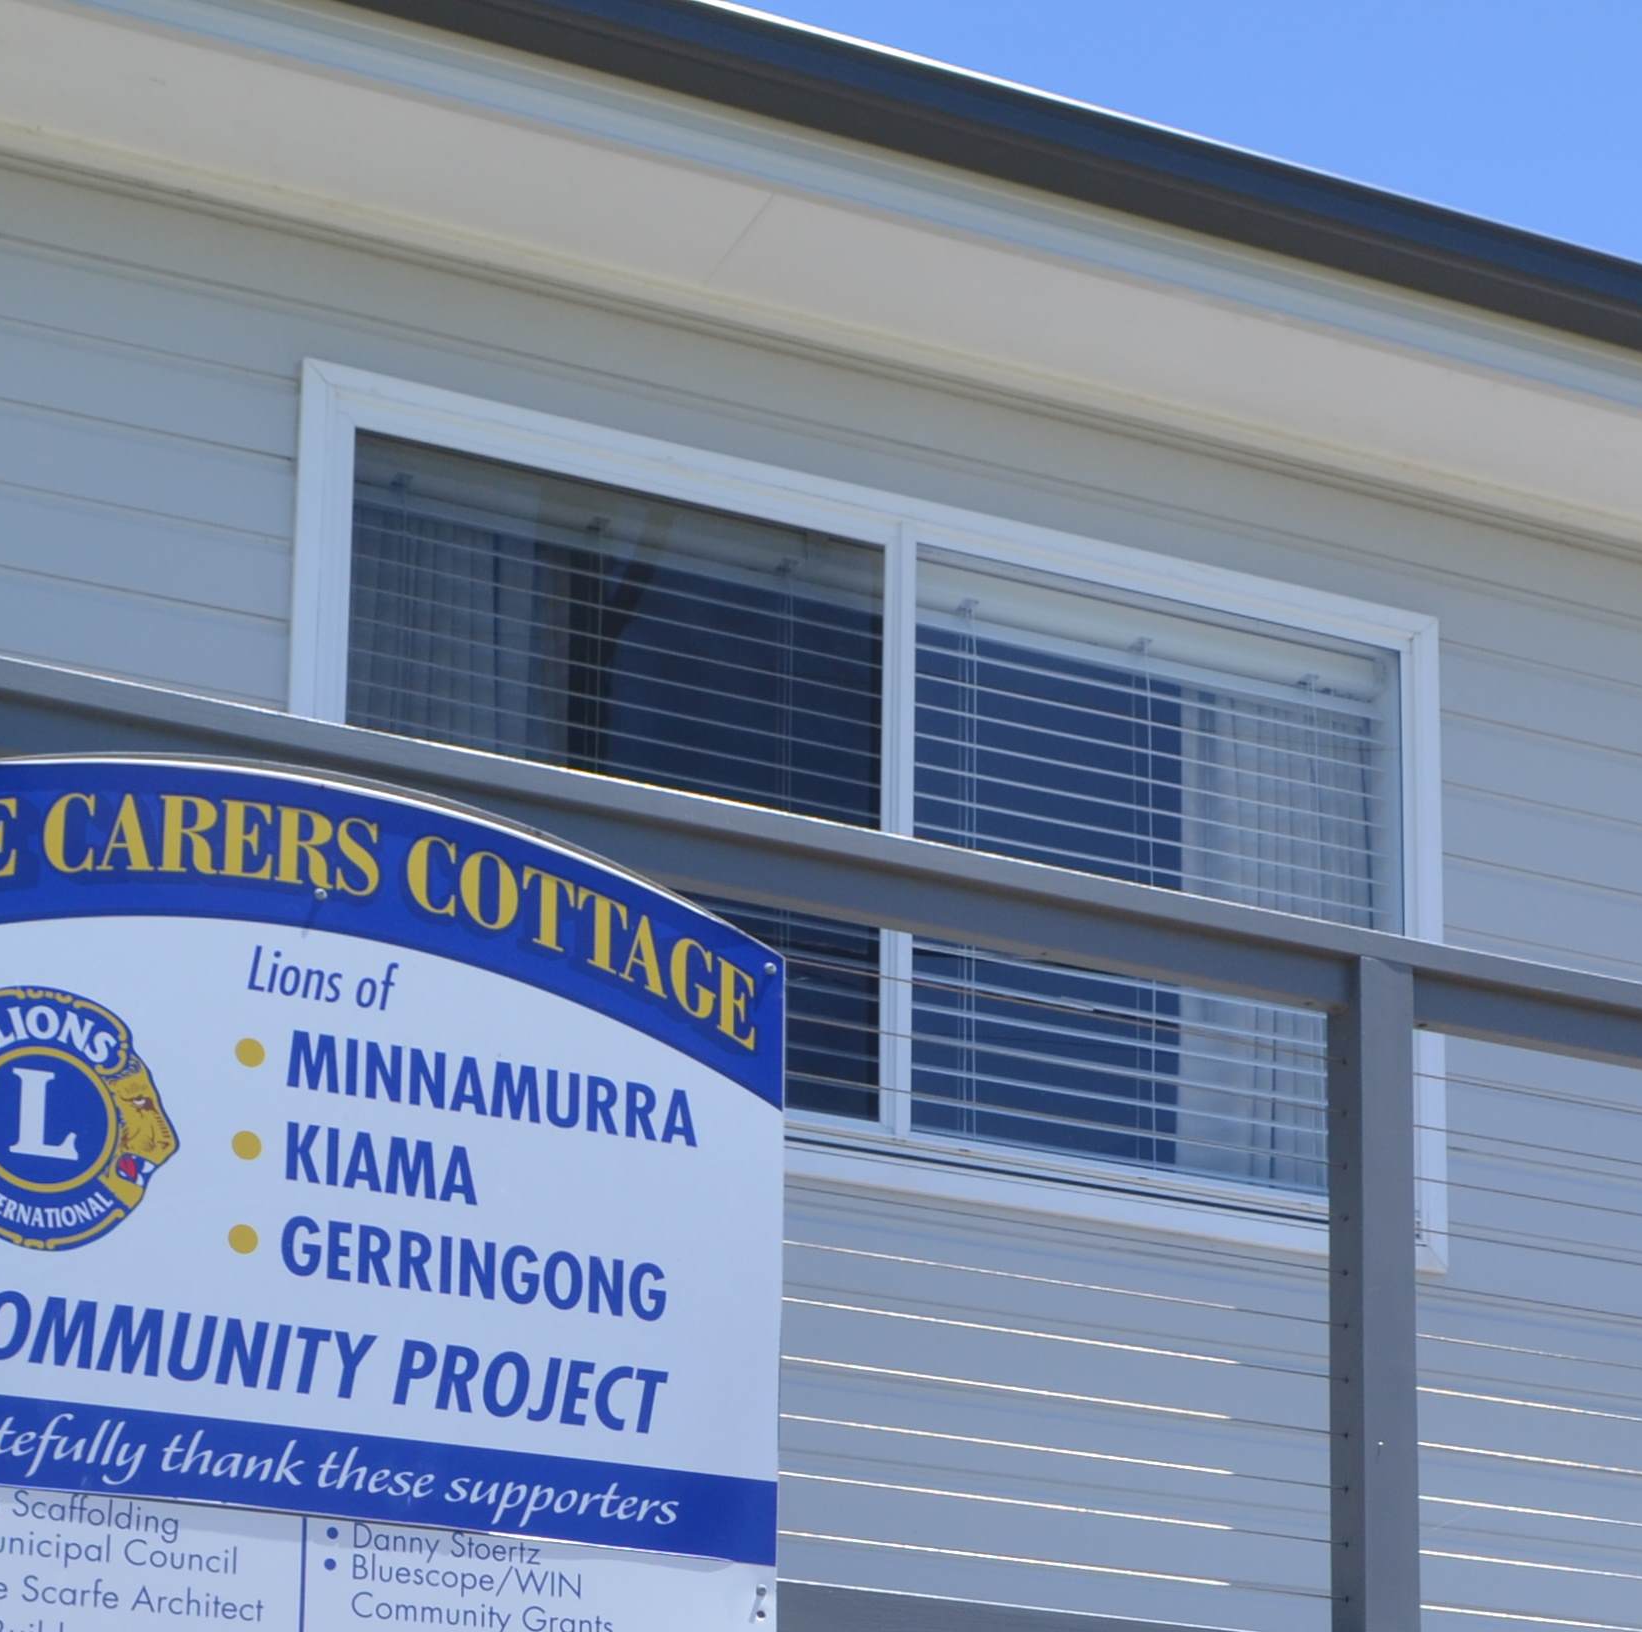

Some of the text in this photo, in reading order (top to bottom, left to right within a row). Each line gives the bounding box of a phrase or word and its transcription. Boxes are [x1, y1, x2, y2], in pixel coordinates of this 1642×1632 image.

[42, 790, 381, 899] CARERS
[405, 833, 759, 1055] COTTAGE
[246, 943, 399, 1014] Lions of
[7, 1065, 81, 1163] L
[285, 1028, 699, 1150] MINNAMURRA
[283, 1120, 480, 1208] KIAMA
[280, 1215, 670, 1323] GERRINGONG
[393, 1338, 670, 1436] PROJECT
[158, 1435, 304, 1487] thank
[316, 1449, 435, 1502] these
[441, 1467, 682, 1528] supporters
[21, 1575, 119, 1609] Scarfe
[131, 1585, 264, 1622] Architect
[124, 1539, 237, 1574] Council
[351, 1556, 581, 1600] Bluescope/WIN
